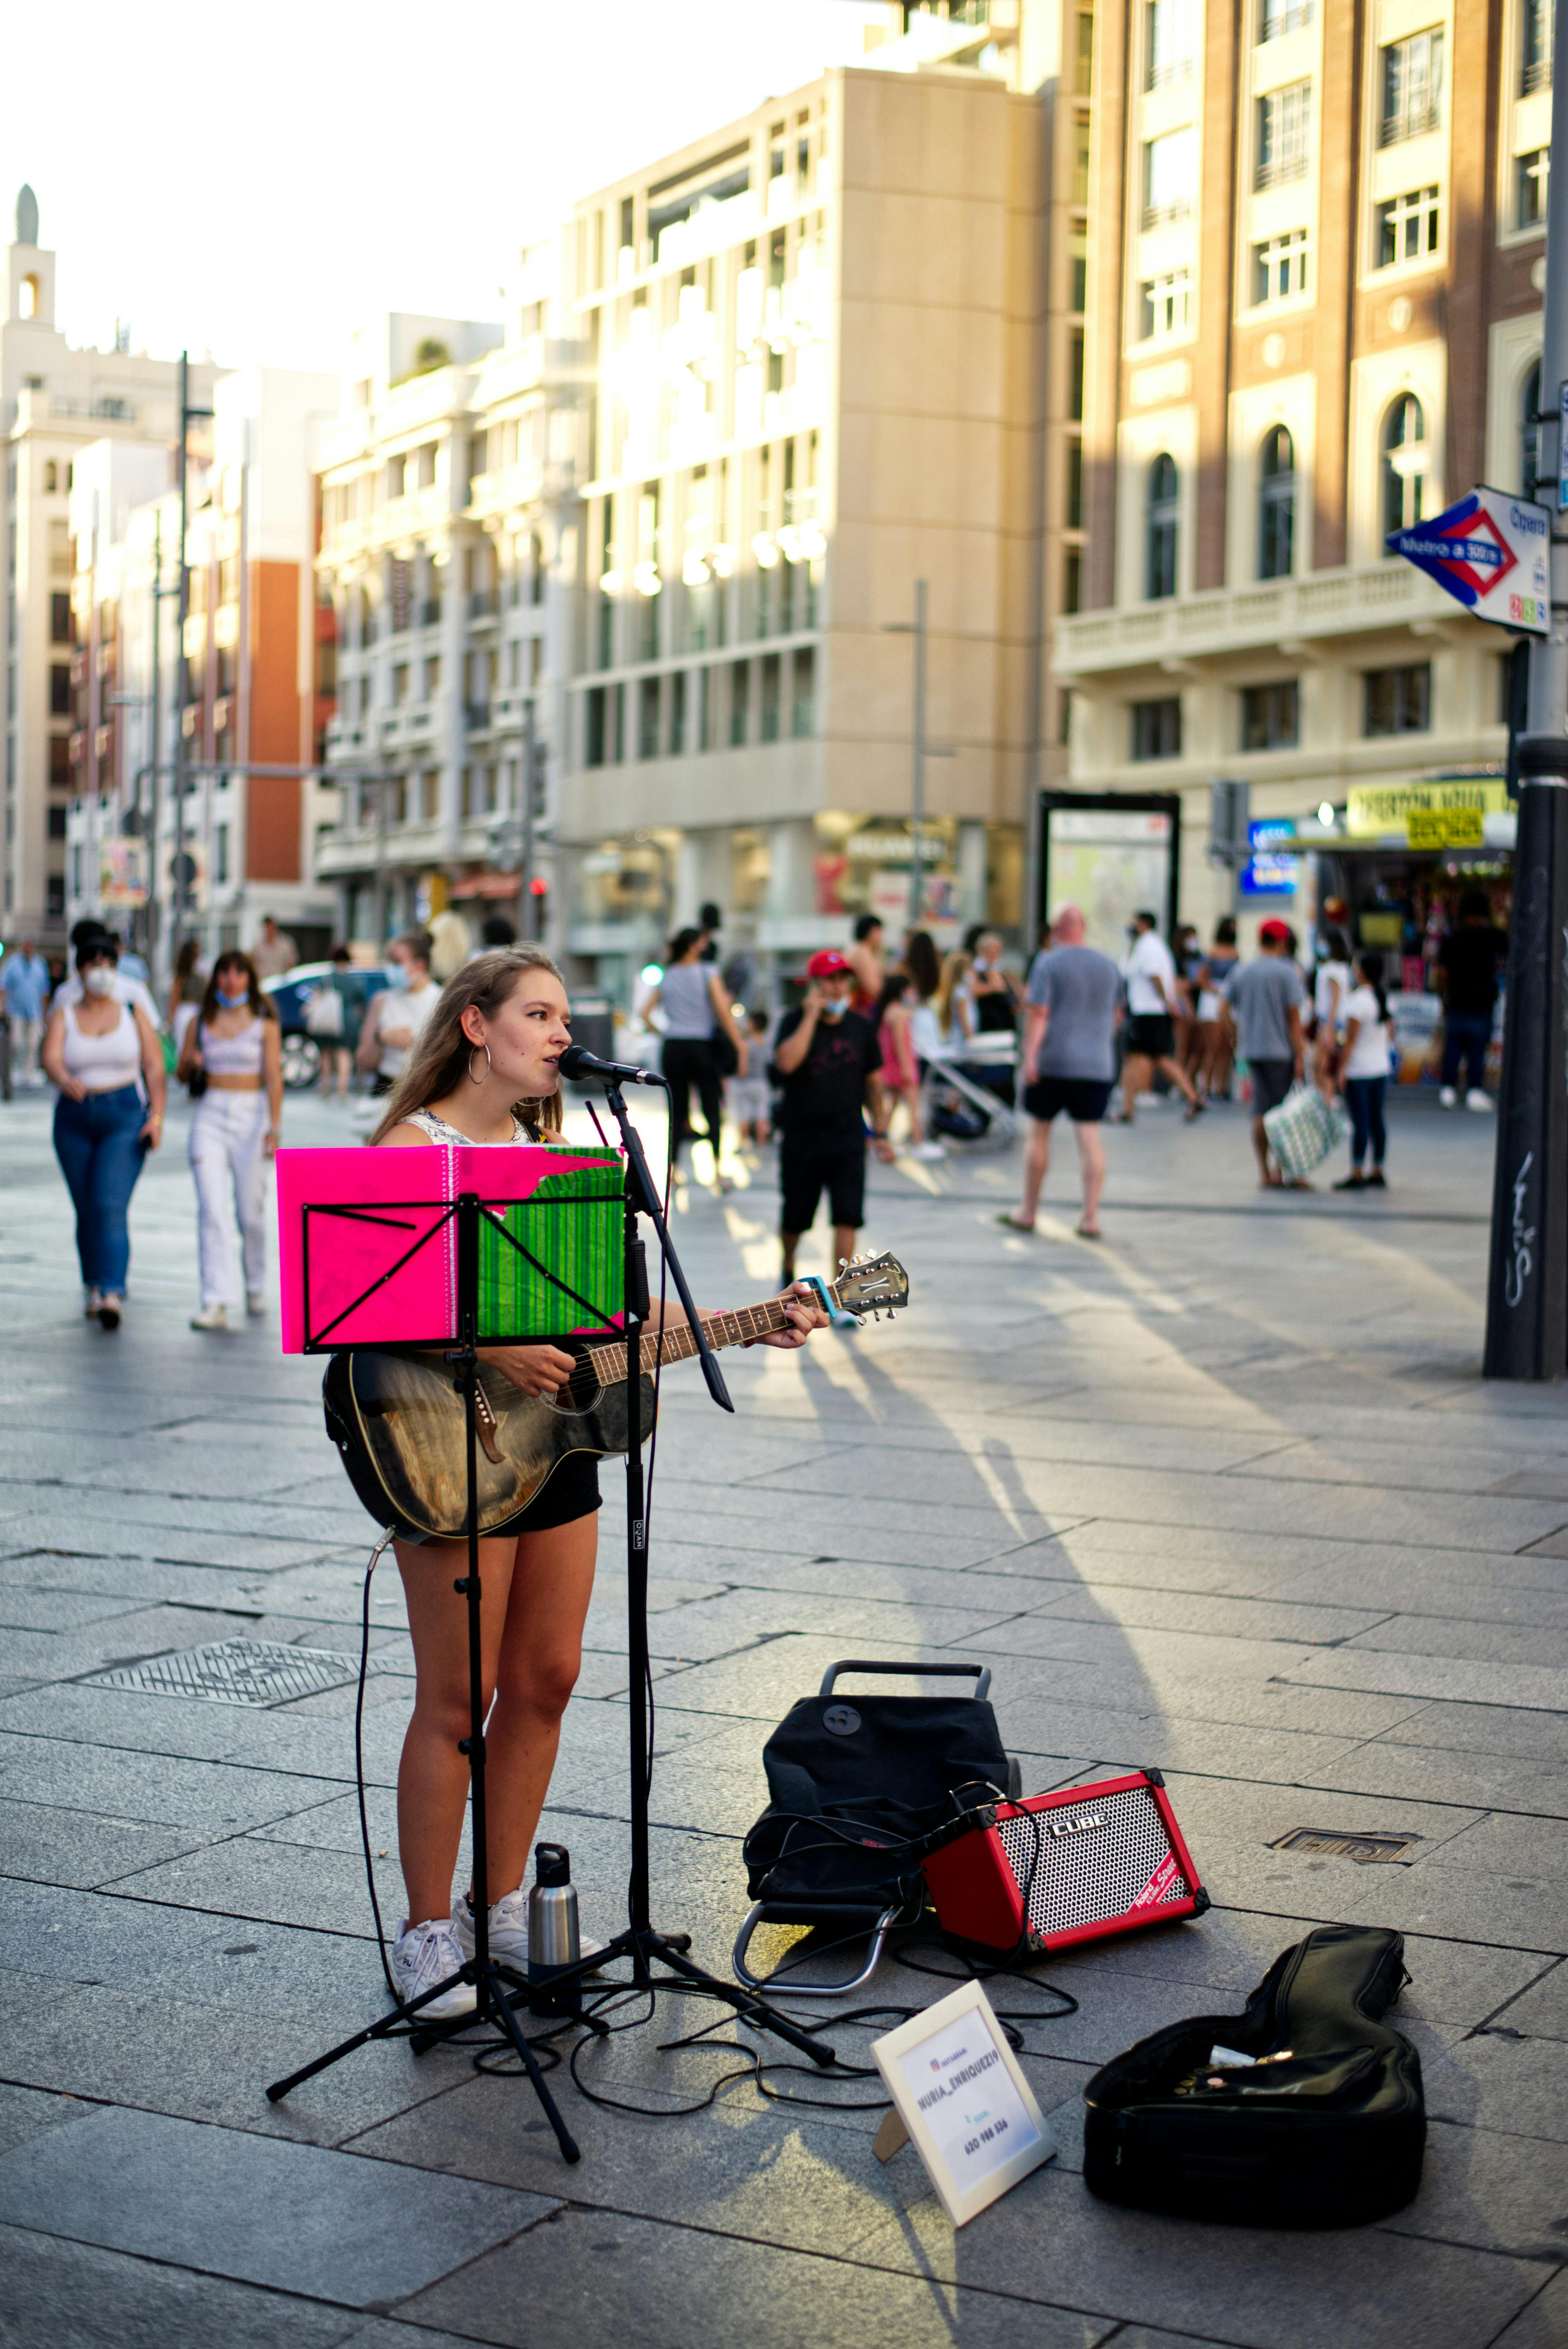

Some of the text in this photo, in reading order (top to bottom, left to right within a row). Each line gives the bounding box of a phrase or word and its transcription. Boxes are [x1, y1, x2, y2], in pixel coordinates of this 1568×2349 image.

[1400, 536, 1450, 558] Metro
[1452, 543, 1465, 559] a
[886, 1263, 905, 1293] Fender
[1052, 1813, 1109, 1836] CUBE
[1146, 1858, 1177, 1904] CUBE Street
[1135, 1883, 1154, 1908] Roland
[918, 2049, 998, 2112] NURIA_ENRIQUEZ19
[965, 2138, 979, 2155] 620
